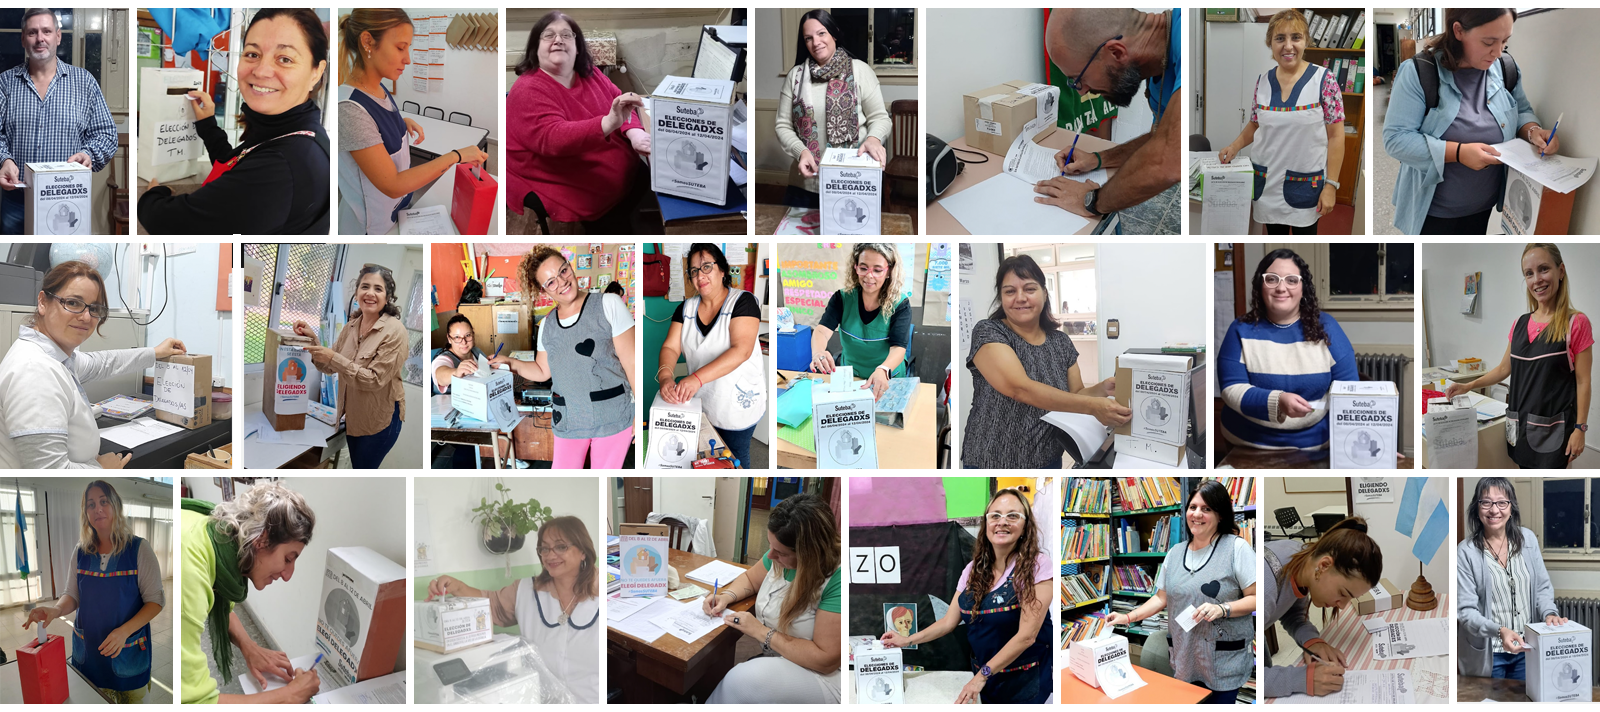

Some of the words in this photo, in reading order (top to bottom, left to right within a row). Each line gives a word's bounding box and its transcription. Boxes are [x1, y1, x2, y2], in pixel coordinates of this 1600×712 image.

[676, 106, 696, 116] Suteba
[664, 115, 705, 124] ELECCIONES
[658, 119, 724, 135] DELEGADXS
[157, 133, 197, 146] DELEGADOS
[40, 188, 88, 196] DELEGADXS
[781, 260, 838, 270] IMPORTANTE
[782, 270, 837, 280] ASOMBROSO
[783, 279, 813, 288] AMIGO
[784, 288, 833, 299] RESPETADO
[785, 297, 826, 308] ESPECIAL
[1136, 384, 1178, 394] DELEGADXS
[821, 414, 870, 425] DELEGADXS
[655, 421, 696, 430] DELEGADXS
[1098, 650, 1126, 663] DELEGADXS
[1546, 647, 1588, 656] DELEGADXS
